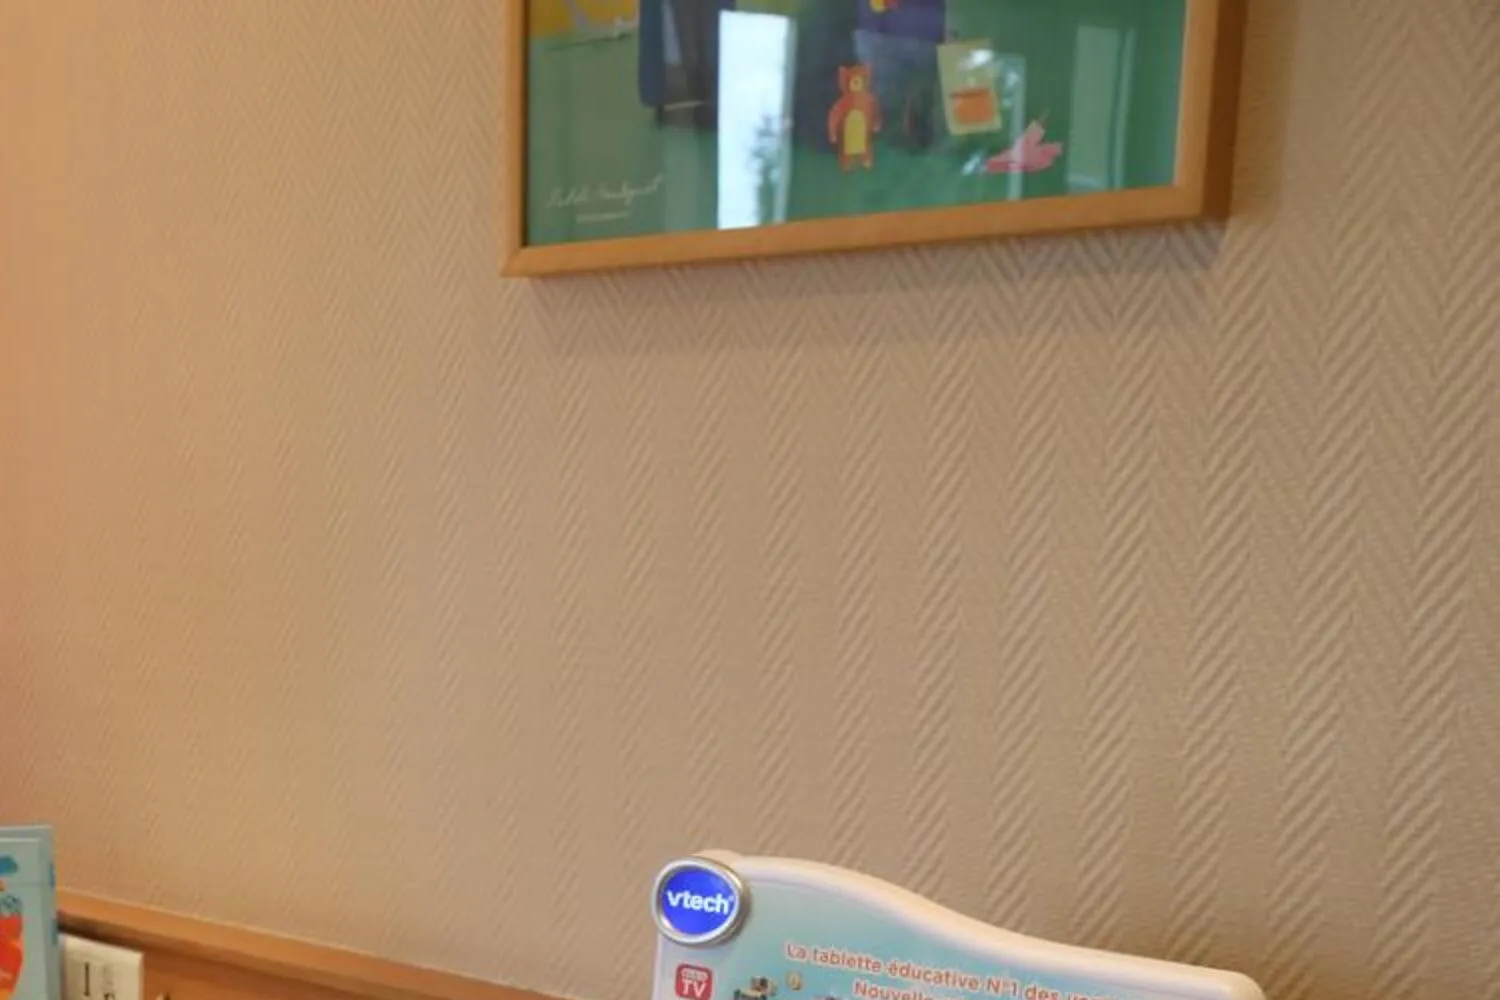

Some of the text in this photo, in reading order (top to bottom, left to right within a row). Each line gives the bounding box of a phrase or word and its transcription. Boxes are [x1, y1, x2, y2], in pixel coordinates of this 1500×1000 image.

[666, 889, 730, 915] vtech
[786, 944, 807, 962] La
[812, 949, 882, 973] tablette
[887, 956, 988, 991] éducative
[682, 979, 708, 999] TV
